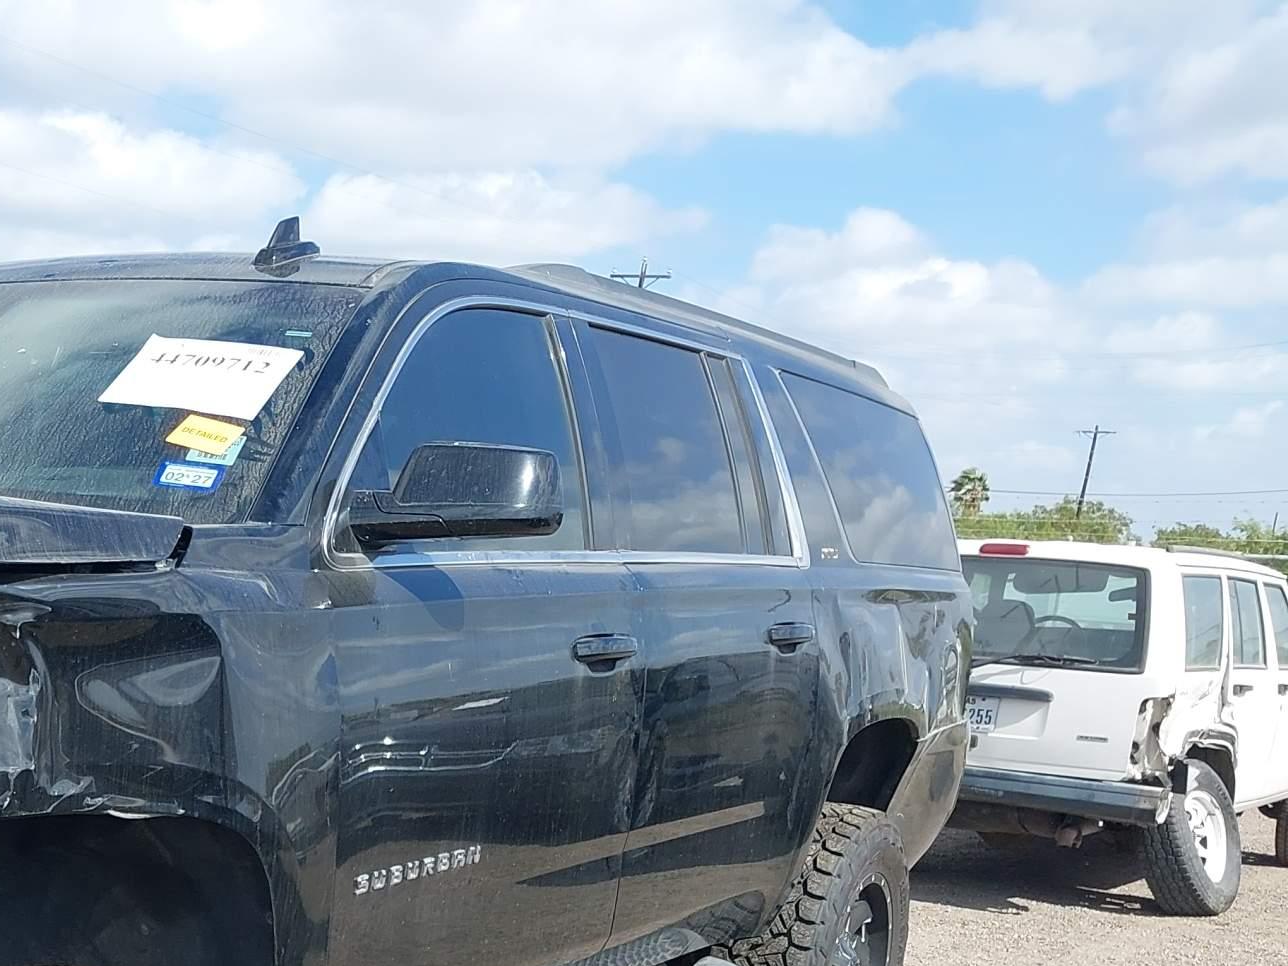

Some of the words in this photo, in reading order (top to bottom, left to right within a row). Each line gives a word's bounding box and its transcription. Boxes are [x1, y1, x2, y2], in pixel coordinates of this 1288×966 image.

[151, 352, 271, 374] 44709712
[181, 426, 229, 444] DETAILED
[165, 471, 185, 482] 02
[190, 474, 213, 484] 27
[354, 845, 482, 896] SUBURBAN
